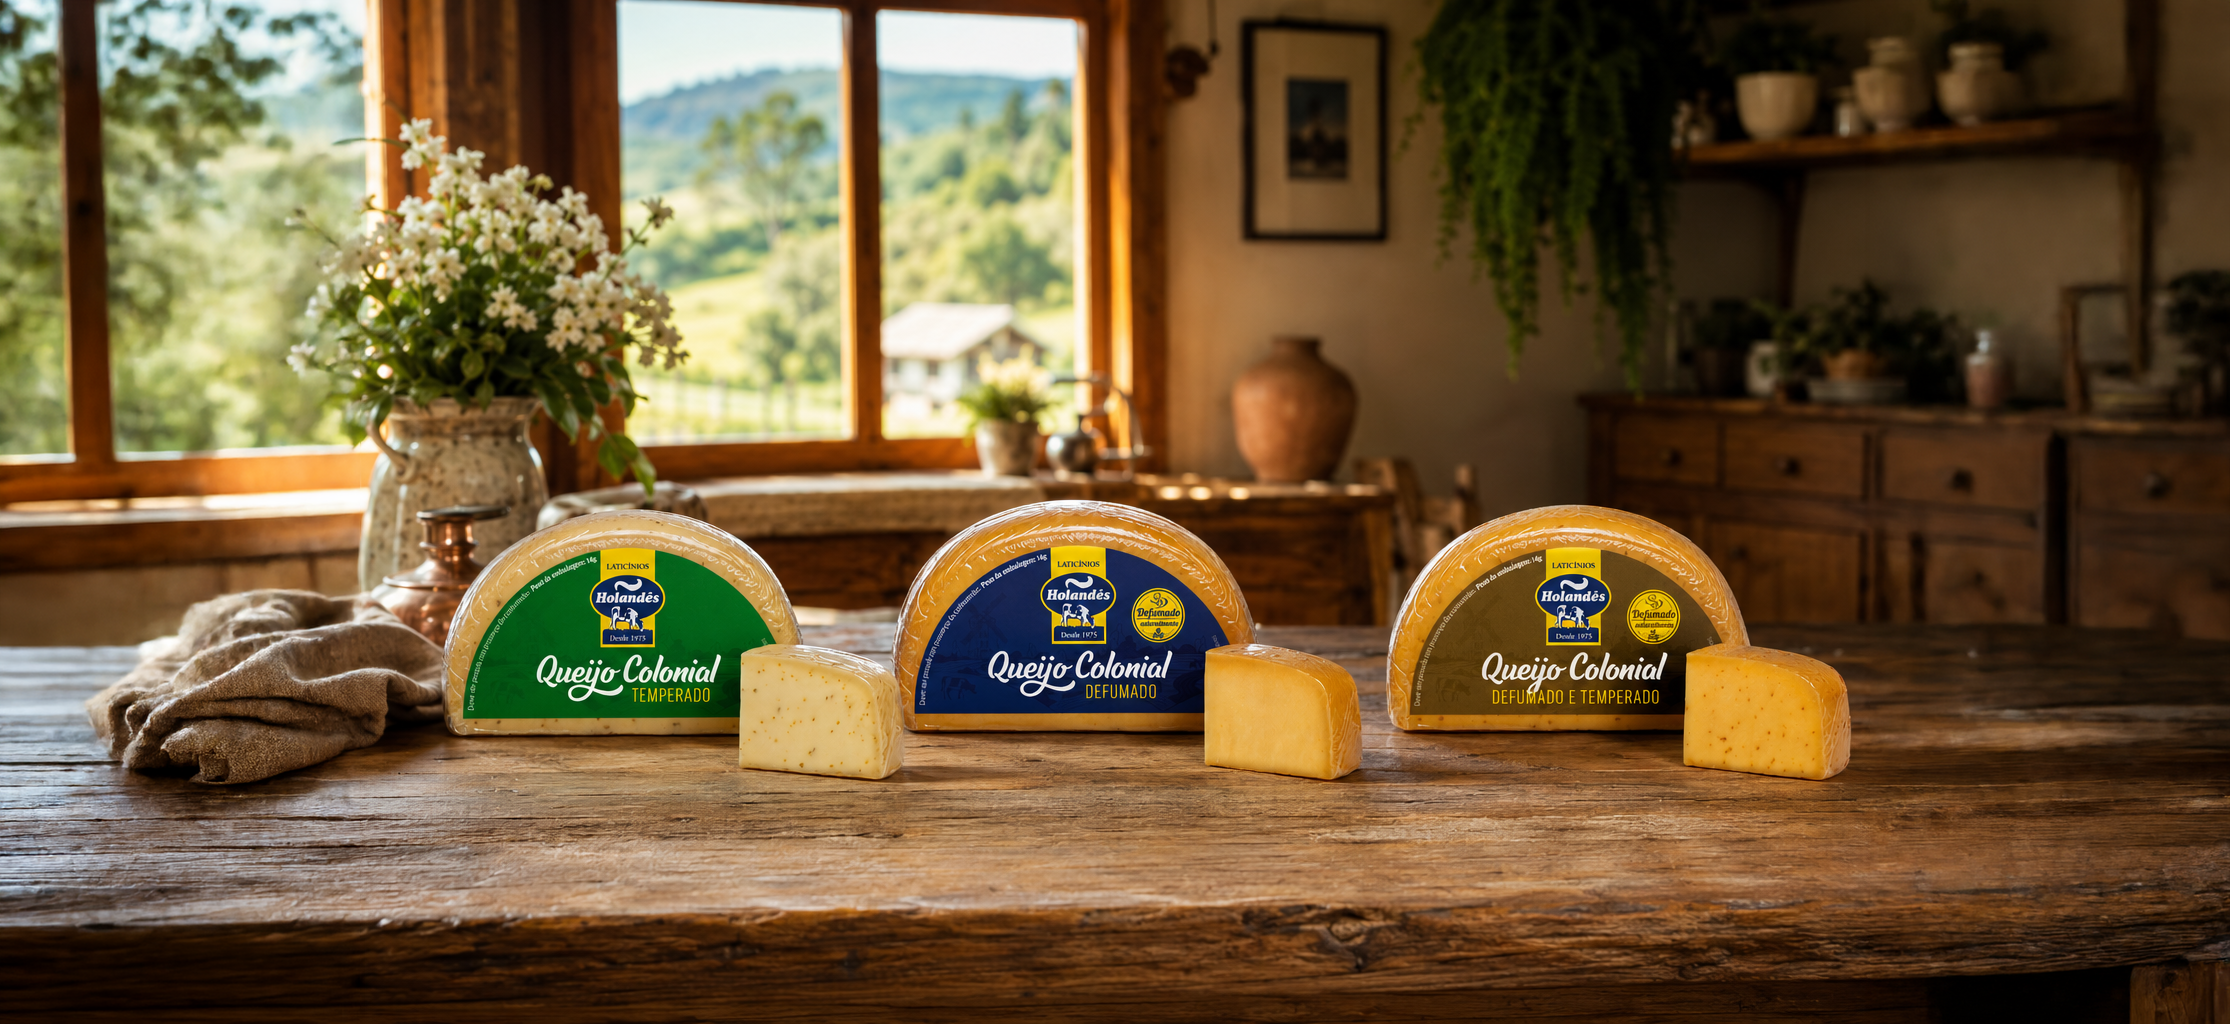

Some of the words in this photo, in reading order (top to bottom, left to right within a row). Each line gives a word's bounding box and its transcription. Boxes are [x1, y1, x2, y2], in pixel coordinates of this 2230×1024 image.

[606, 562, 650, 570] LATICÍNIOS
[1057, 560, 1100, 568] LATICÍNIOS
[1552, 561, 1596, 569] LATICÍNIOS
[595, 591, 660, 604] Holandês
[1136, 607, 1181, 620] Defumado
[1631, 609, 1676, 622] Defumado
[1082, 631, 1098, 639] 1975
[536, 654, 624, 702] Queijo
[623, 654, 722, 683] Colonial
[987, 650, 1076, 697] Queijo
[1075, 650, 1173, 679] Colonial
[1481, 652, 1567, 694] Queijo
[1569, 652, 1668, 681] Colonial
[631, 687, 711, 703] TEMPERADO
[1085, 684, 1157, 699] DEFUMADO
[1492, 689, 1564, 705] DEFUMADO
[1569, 689, 1576, 705] E
[1580, 689, 1660, 705] TEMPERADO
